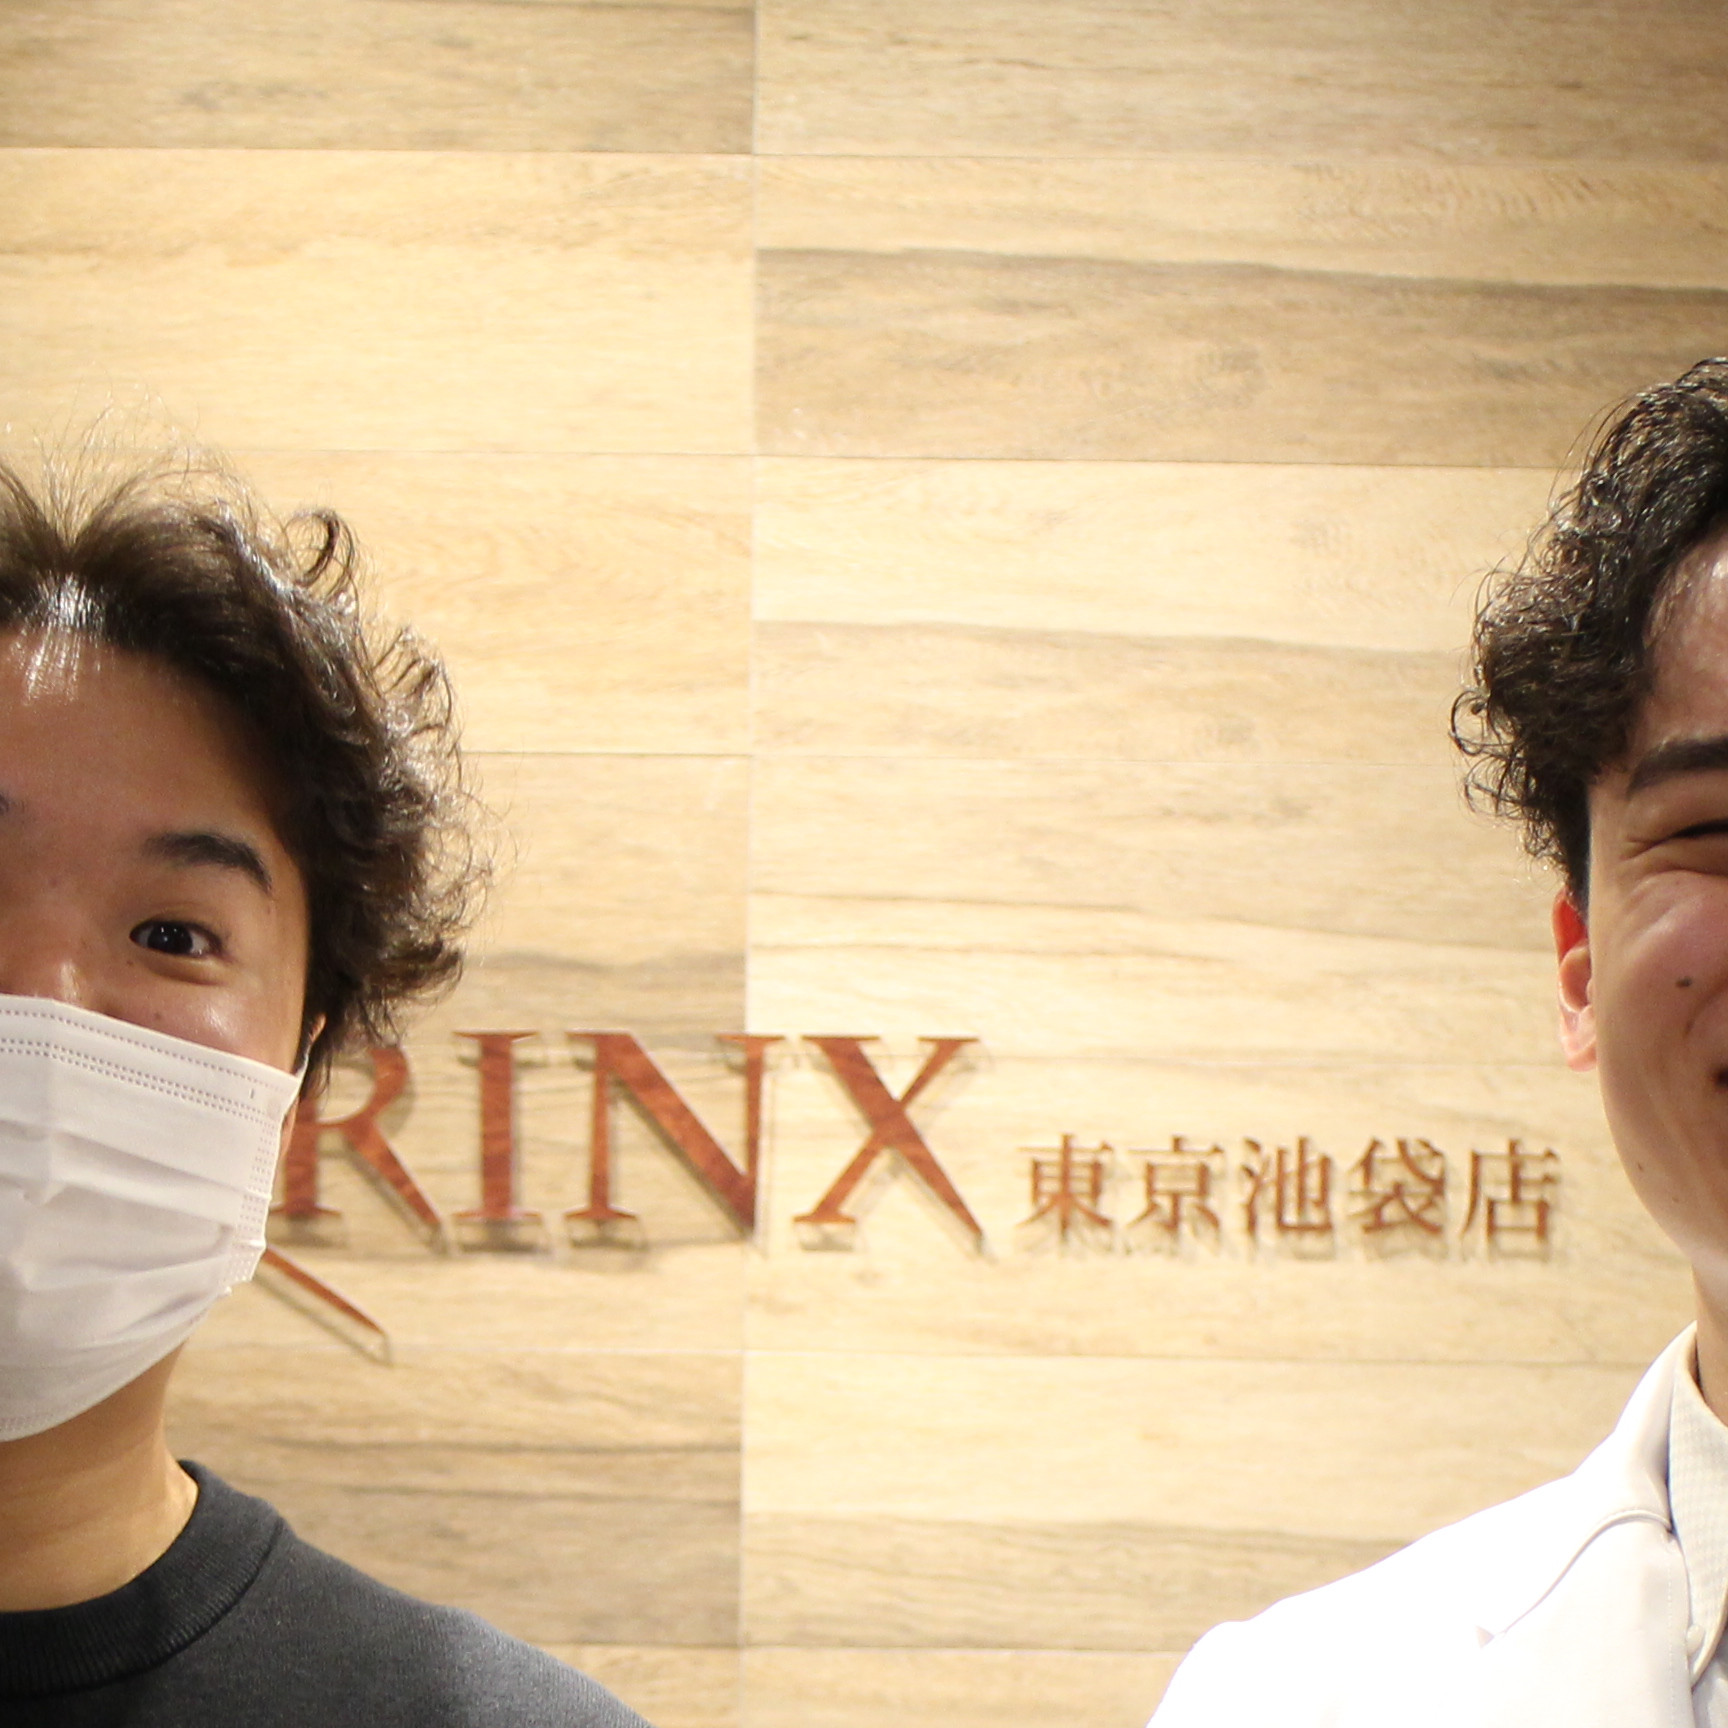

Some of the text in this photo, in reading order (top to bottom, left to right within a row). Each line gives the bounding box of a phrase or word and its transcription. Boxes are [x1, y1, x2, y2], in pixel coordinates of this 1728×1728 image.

[1015, 1133, 1562, 1241] 東京池袋店
